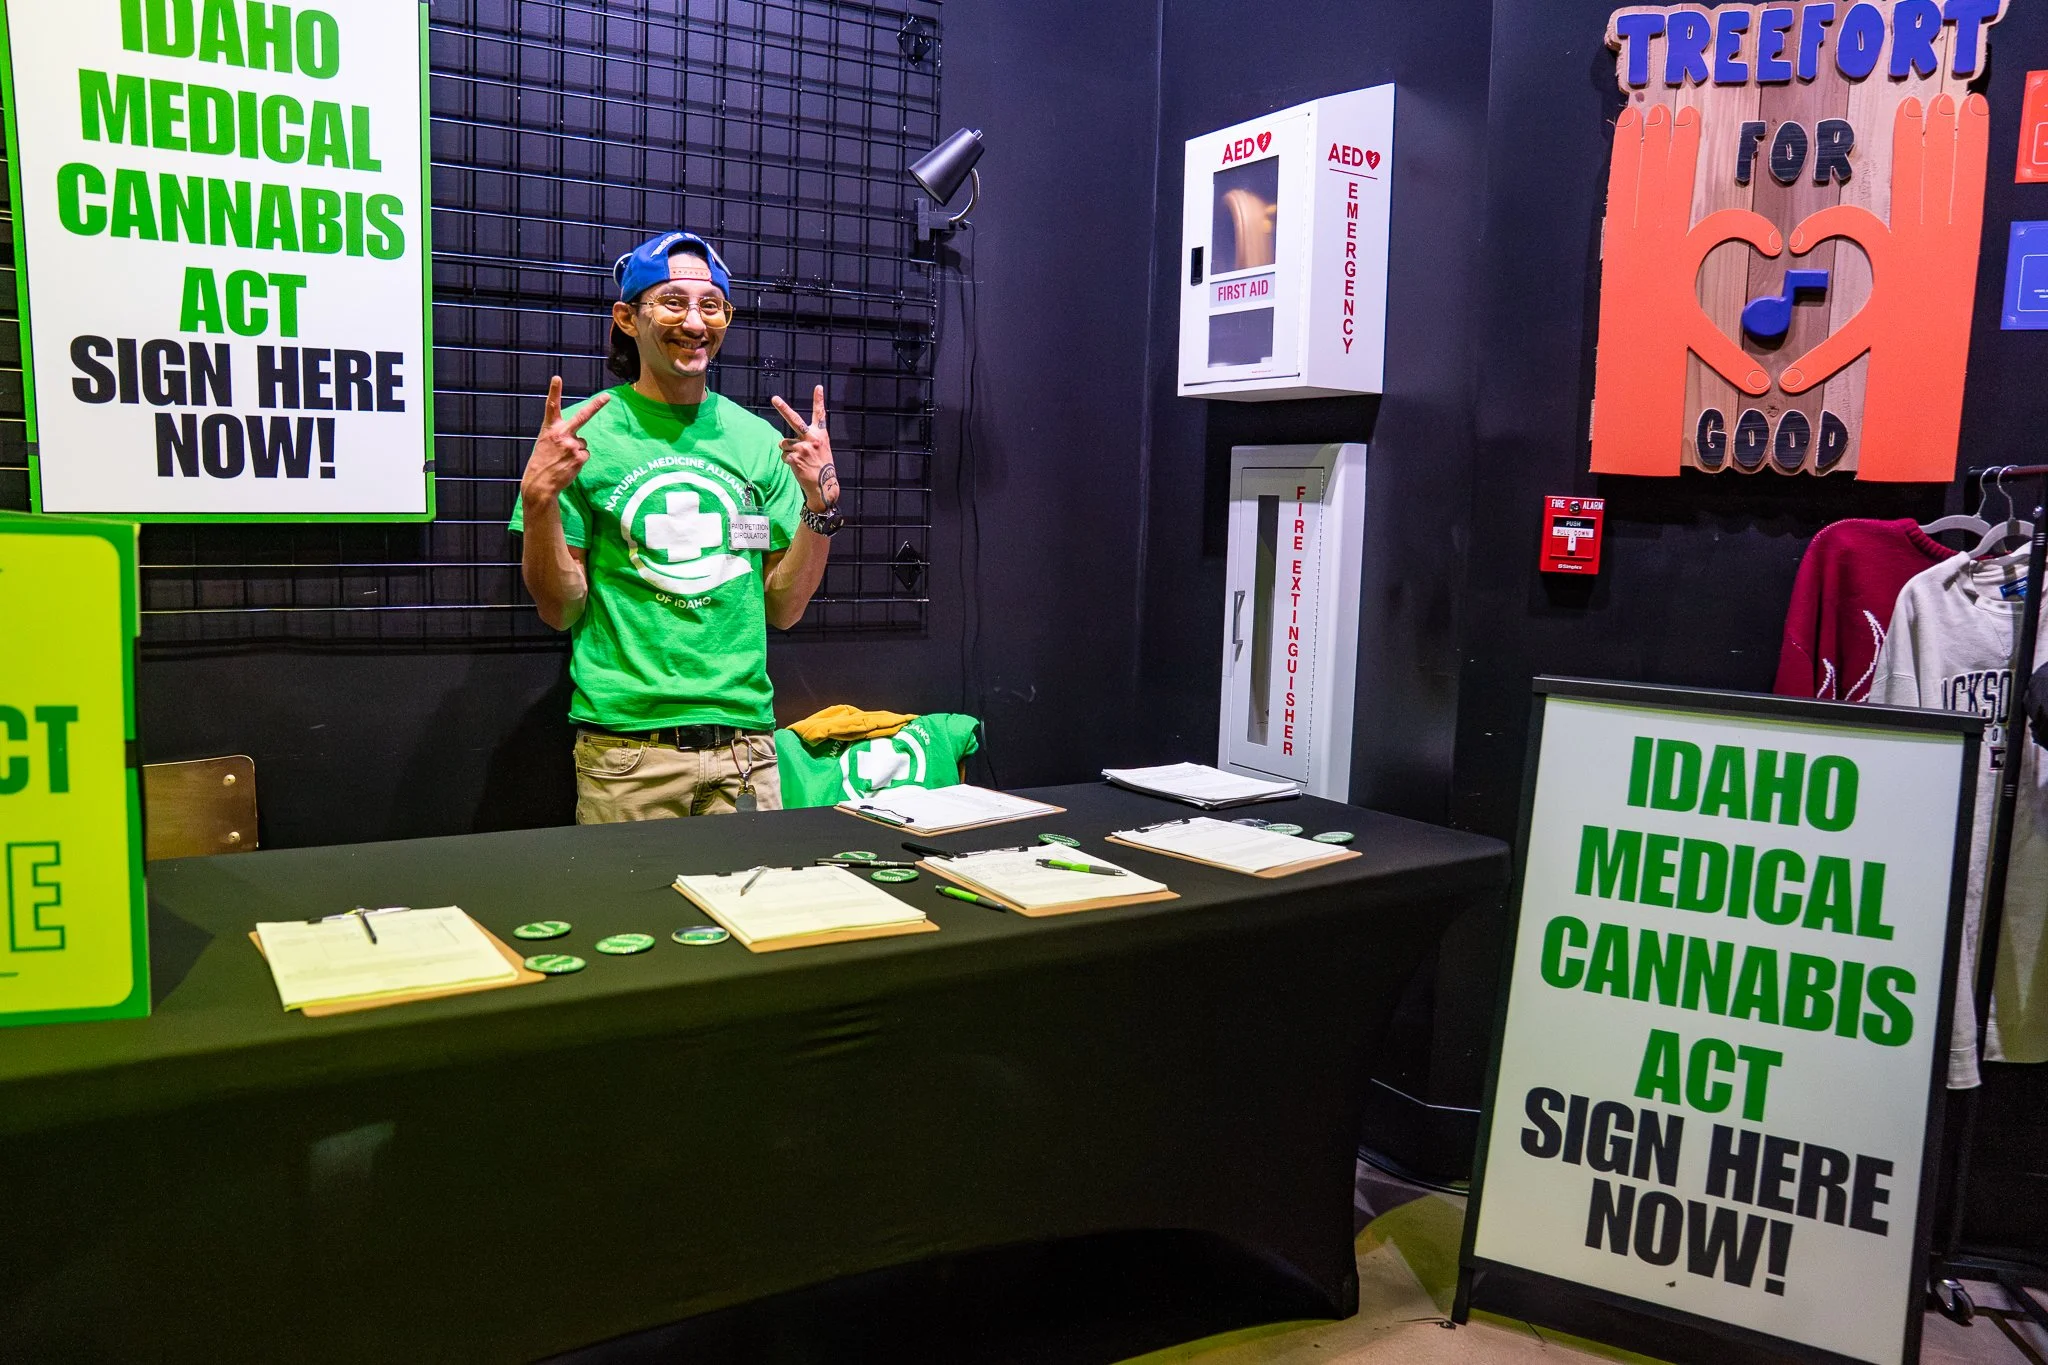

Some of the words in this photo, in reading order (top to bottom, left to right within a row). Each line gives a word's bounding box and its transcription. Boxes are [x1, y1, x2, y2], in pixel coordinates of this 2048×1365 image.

[120, 0, 340, 80] IDAHO
[1615, 0, 2001, 85] TREEFORT
[78, 68, 382, 173] MEDICAL
[1222, 137, 1254, 165] AED
[1327, 143, 1364, 167] AED
[1735, 118, 1855, 183] FOR
[56, 162, 405, 260] CANNABIS
[179, 266, 307, 338] ACT
[1218, 283, 1245, 302] FIRST
[1249, 279, 1269, 298] AID
[1342, 182, 1358, 355] EMERGENCY
[70, 335, 232, 407] SIGN
[257, 345, 405, 413] HERE
[155, 412, 336, 480] NOW!
[1696, 408, 1848, 470] GOOD
[604, 464, 651, 513] NATURAL
[647, 456, 704, 470] MEDICINE
[1294, 486, 1306, 551] FIRE
[1551, 499, 1565, 508] FIRE
[1582, 501, 1603, 510] ALARM
[656, 593, 672, 604] OF
[674, 596, 711, 609] IDAHO
[1283, 560, 1302, 756] EXTINGUISHER
[1627, 736, 1860, 832] IDAHO
[1575, 824, 1894, 941] MEDICAL
[1540, 915, 1916, 1047] CANNABIS
[1634, 1028, 1783, 1122] ACT
[1521, 1087, 1684, 1187] SIGN
[1706, 1125, 1895, 1237] HERE
[1584, 1178, 1794, 1297] NOW!
